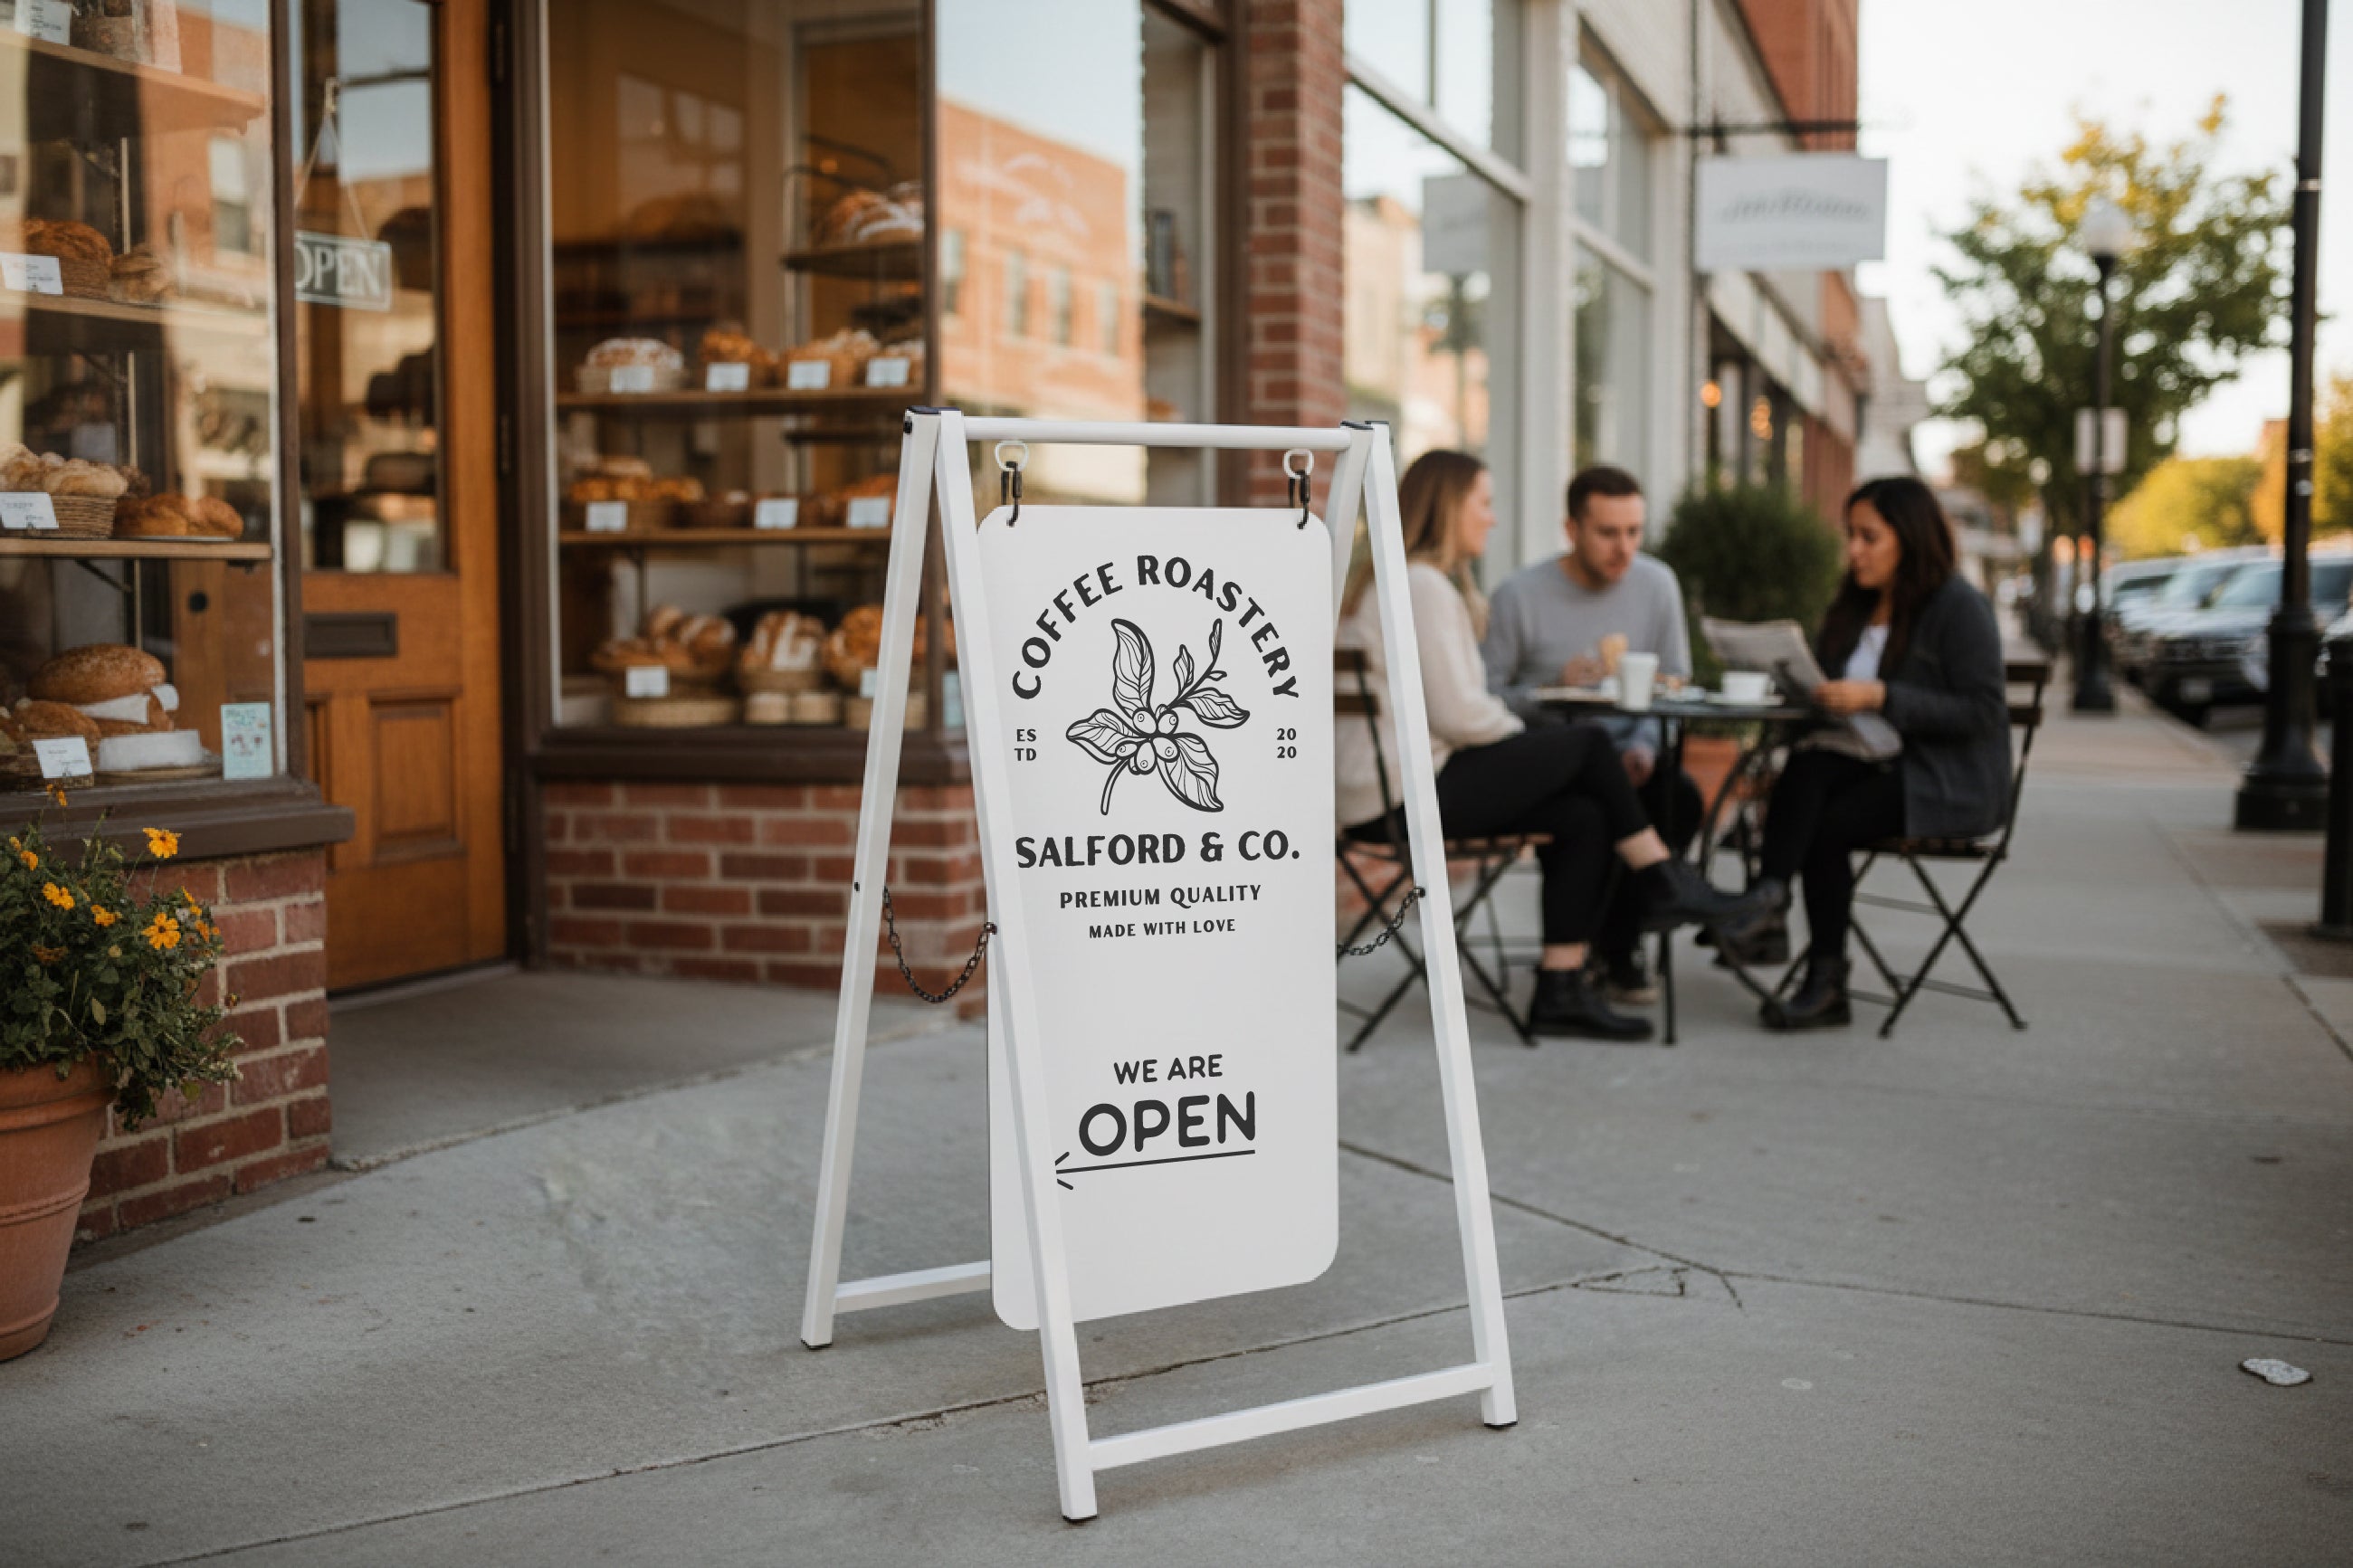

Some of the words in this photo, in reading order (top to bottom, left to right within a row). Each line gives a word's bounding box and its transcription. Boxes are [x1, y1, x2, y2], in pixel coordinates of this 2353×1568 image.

[295, 242, 381, 295] OPEN
[1013, 562, 1122, 699] COFFEE
[1138, 556, 1299, 698] ROASTERY
[1016, 728, 1037, 742] ES
[1276, 727, 1297, 741] 20
[1014, 747, 1037, 762] TD
[1276, 746, 1297, 759] 20
[1015, 834, 1185, 868] SALFORD
[1200, 832, 1224, 862] &
[1238, 830, 1300, 860] CO.
[1060, 889, 1160, 909] PREMIUM
[1169, 884, 1262, 909] QUALITY
[1089, 923, 1137, 939] MADE
[1143, 921, 1186, 936] WITH
[1193, 918, 1236, 934] LOVE
[1113, 1059, 1158, 1085] WE
[1167, 1053, 1224, 1081] ARE
[1079, 1091, 1256, 1157] OPEN
